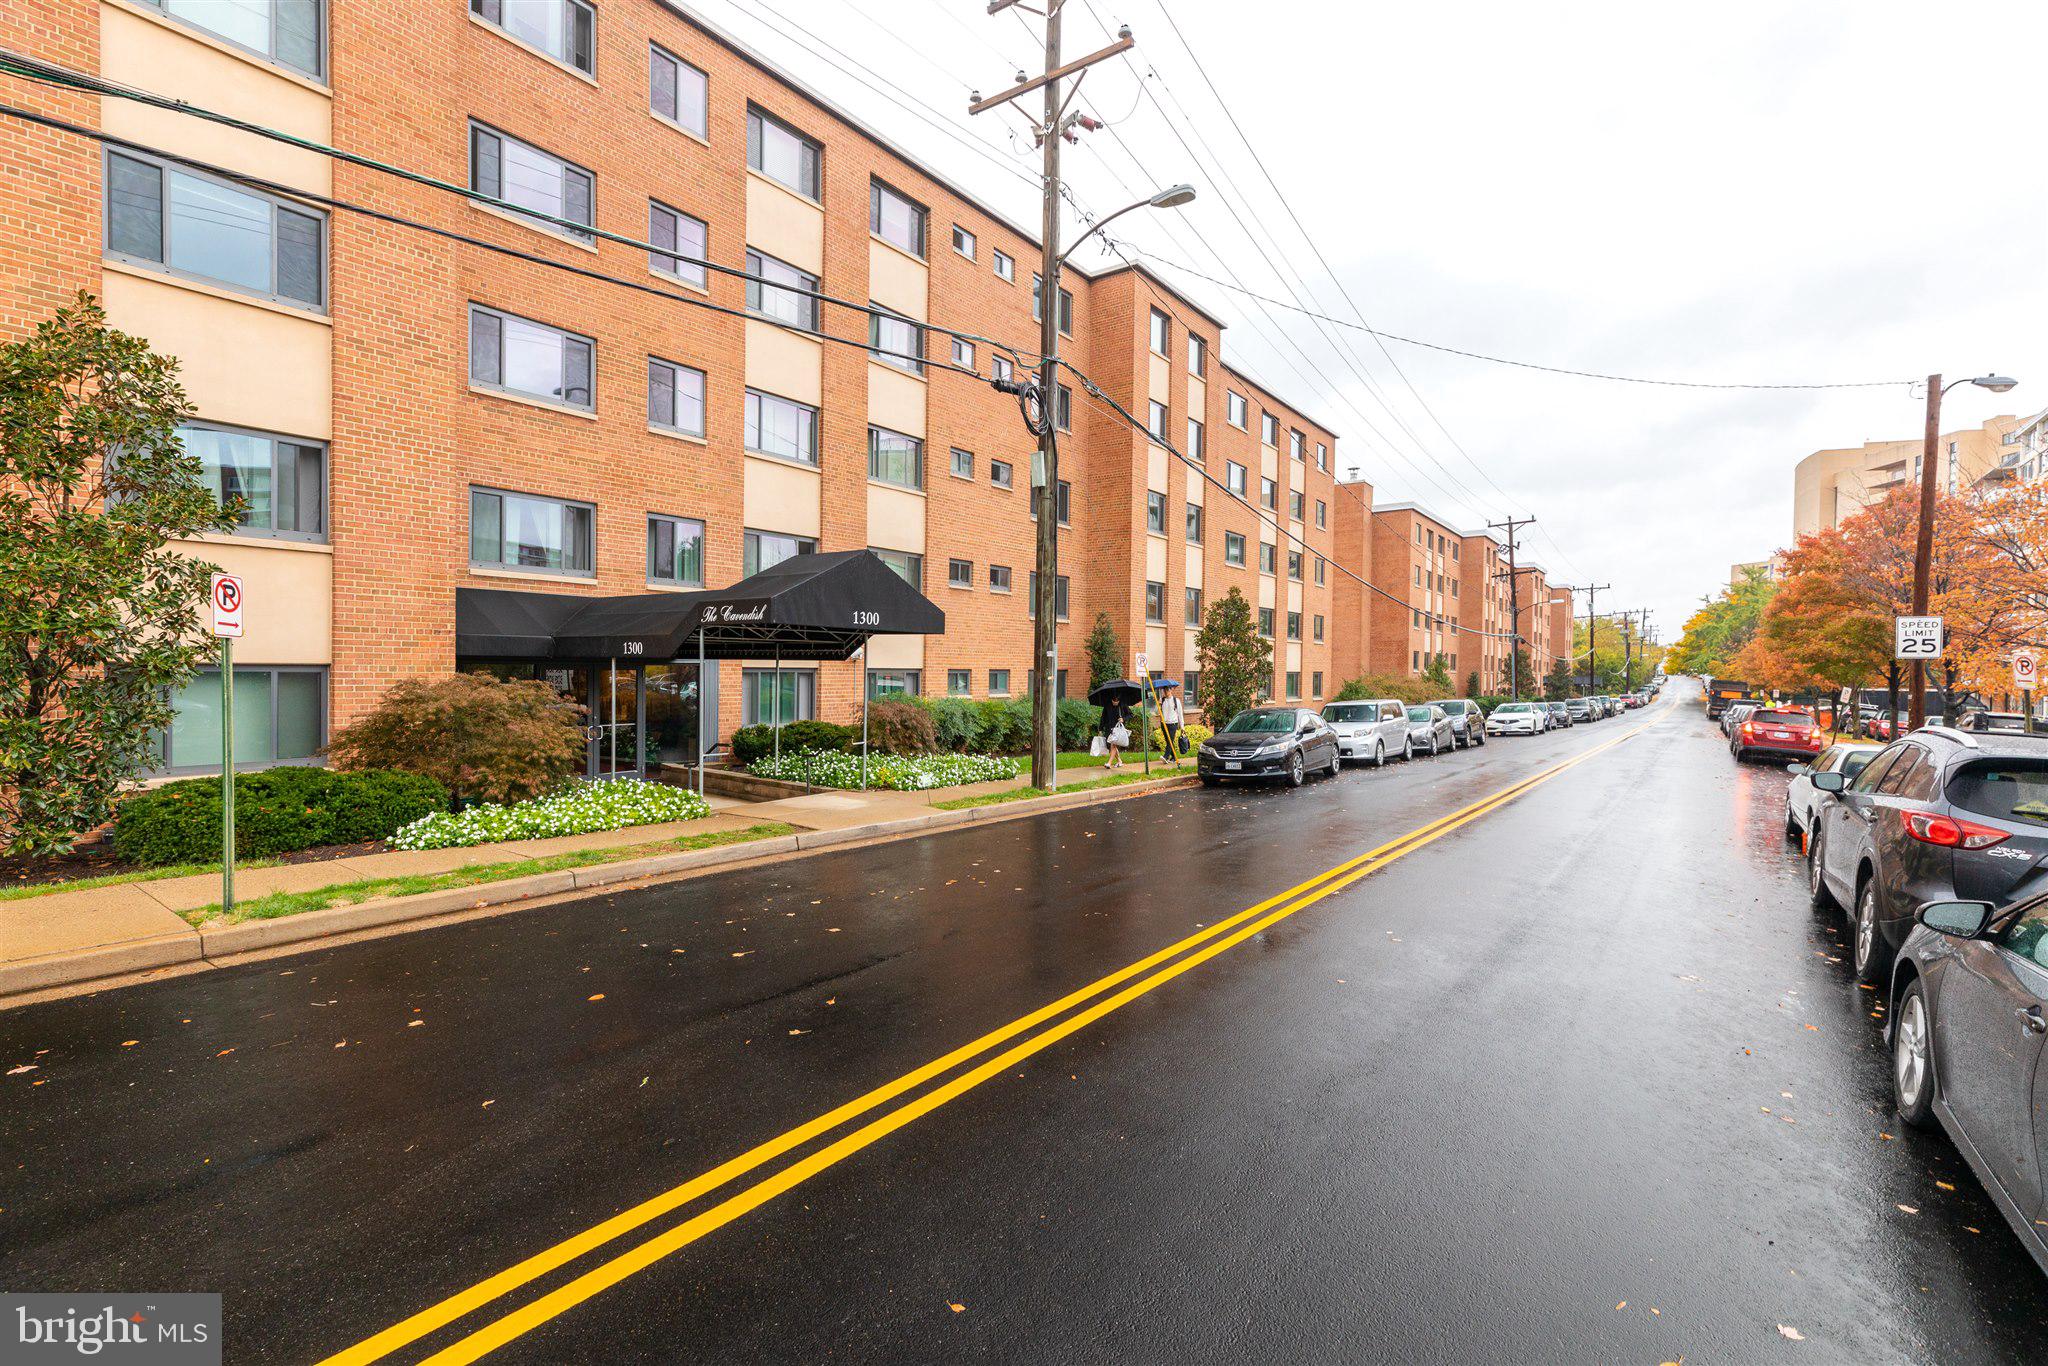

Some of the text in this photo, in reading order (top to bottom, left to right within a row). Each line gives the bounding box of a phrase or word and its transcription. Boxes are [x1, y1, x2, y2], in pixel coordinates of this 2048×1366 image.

[700, 604, 767, 623] The Cavendish
[853, 610, 880, 626] 1300
[1901, 621, 1939, 629] SPEED
[1904, 629, 1935, 637] LIMIT
[623, 641, 643, 655] 1300
[1901, 638, 1937, 653] 25
